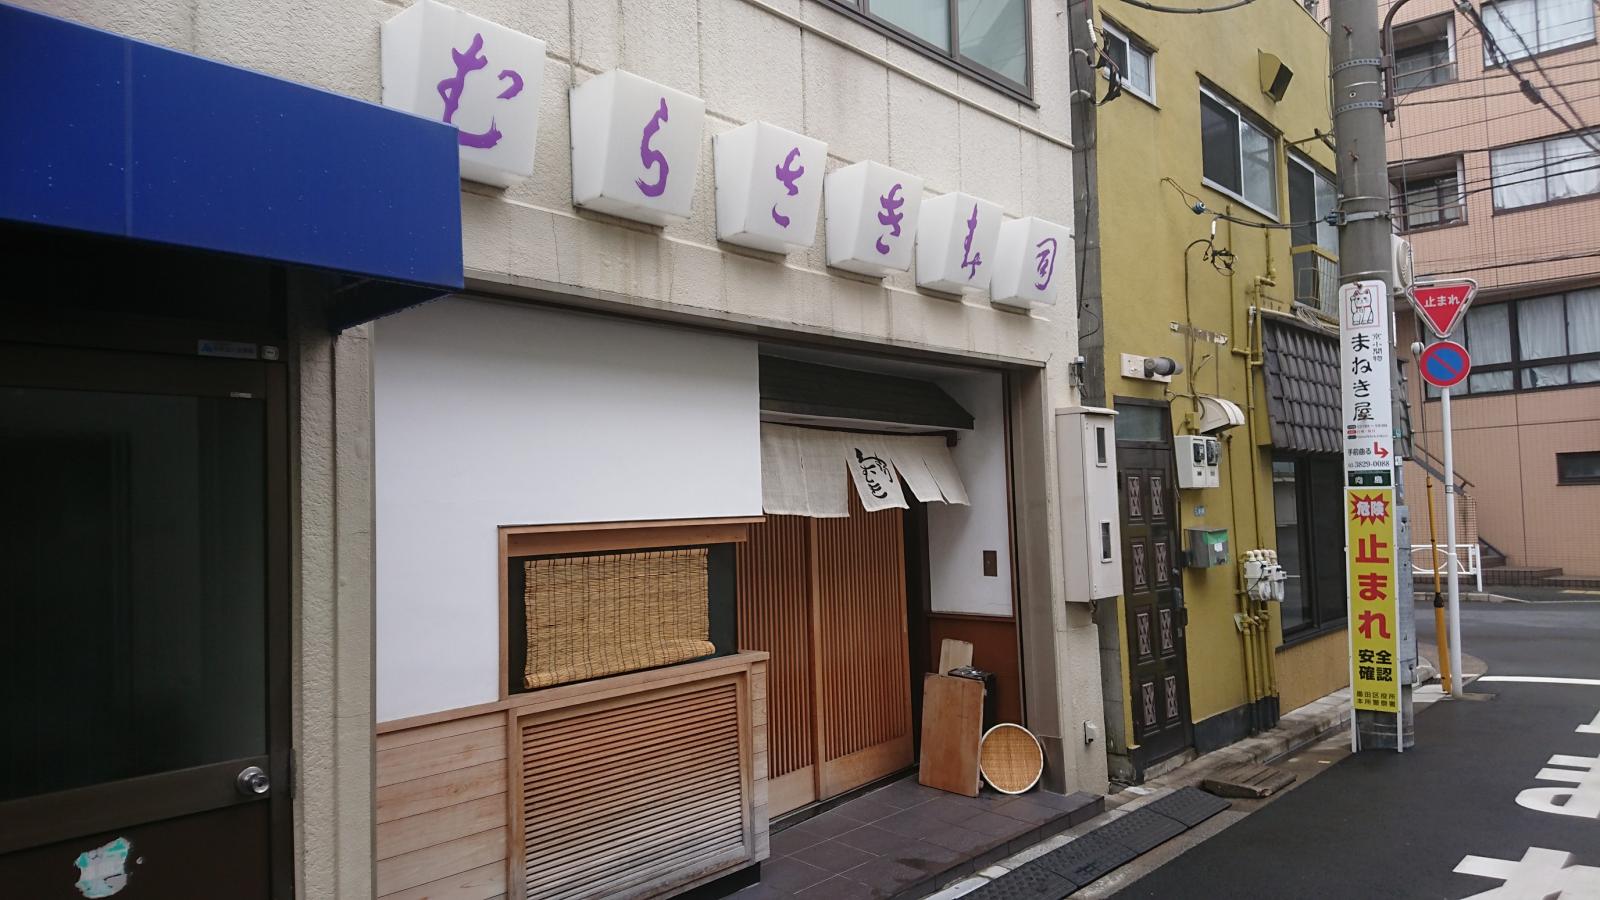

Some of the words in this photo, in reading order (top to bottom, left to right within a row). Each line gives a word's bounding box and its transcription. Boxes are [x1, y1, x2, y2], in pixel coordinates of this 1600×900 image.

[1424, 294, 1460, 308] 止まれ
[1351, 332, 1375, 421] まねき屋
[1356, 501, 1385, 517] 危険
[1355, 534, 1390, 640] 止まれ
[1359, 649, 1392, 665] 安全
[1359, 665, 1393, 682] 確認
